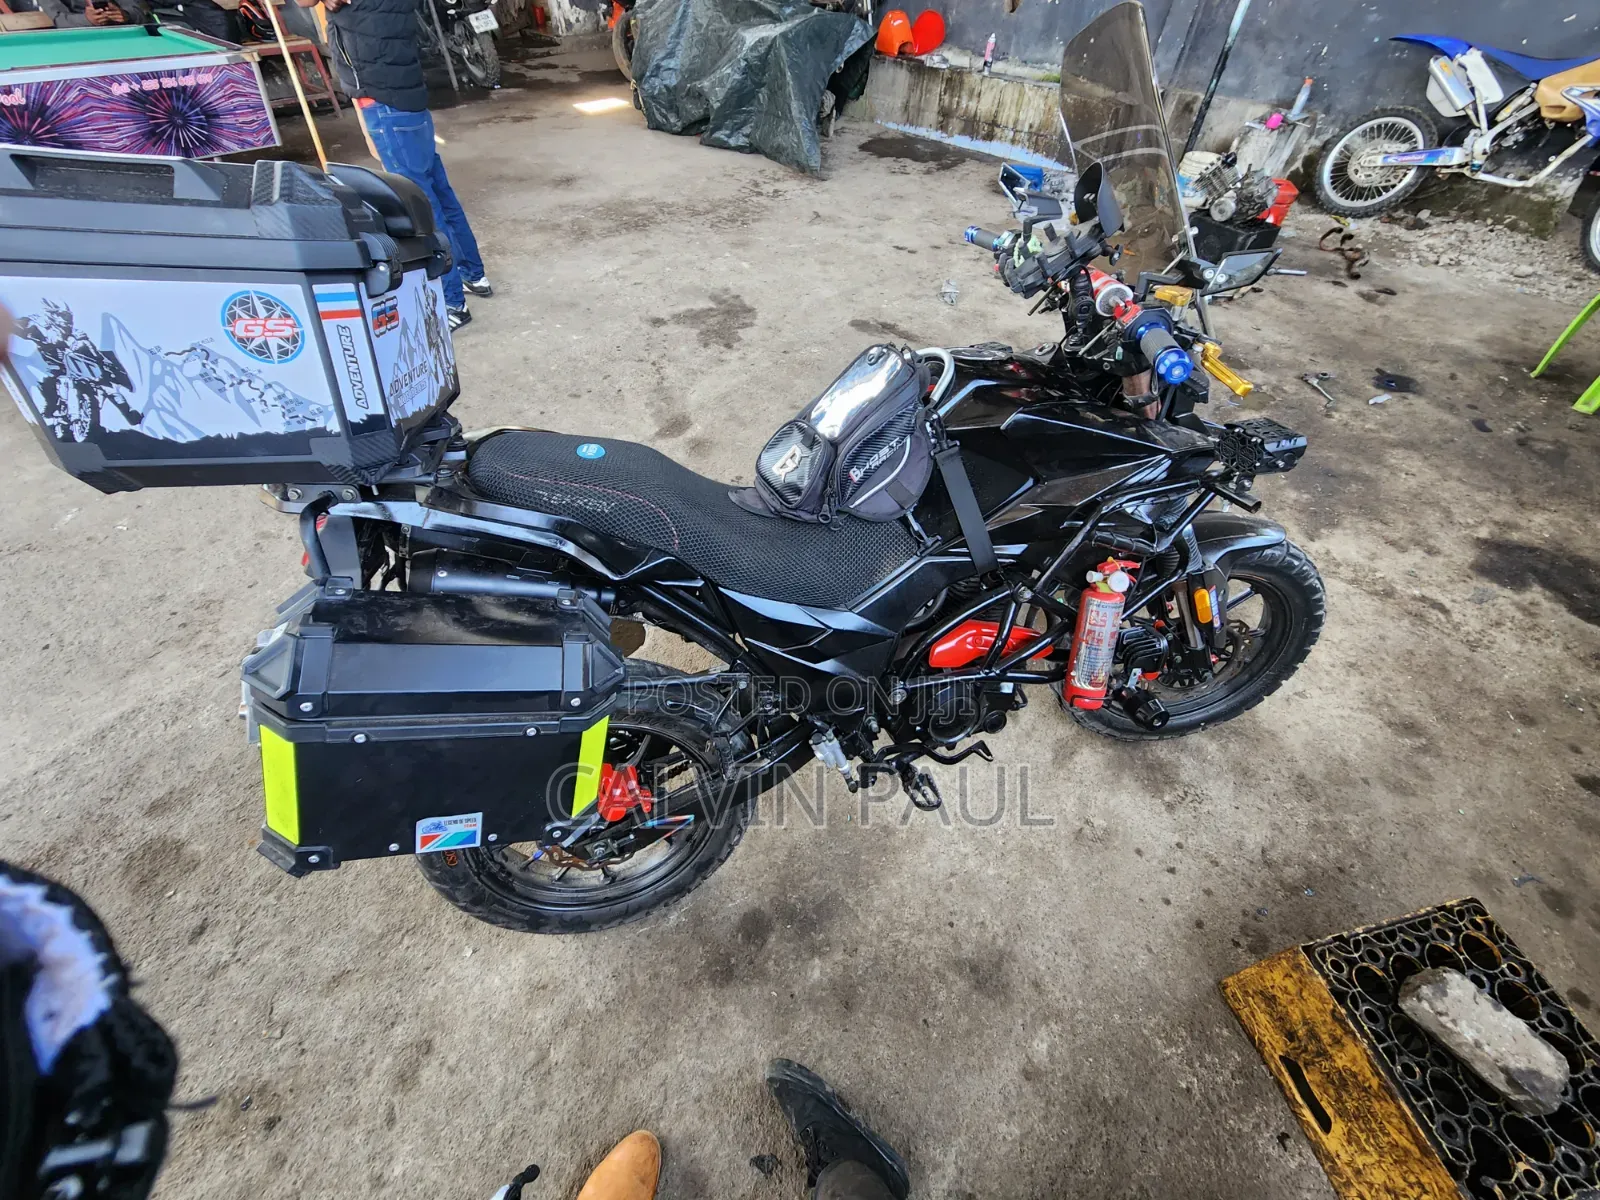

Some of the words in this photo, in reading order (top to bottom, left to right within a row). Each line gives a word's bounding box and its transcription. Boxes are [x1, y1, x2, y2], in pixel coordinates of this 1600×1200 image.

[0, 88, 26, 106] ool
[232, 317, 296, 339] GS
[371, 295, 399, 338] GS
[336, 324, 369, 409] ADVENTURE
[389, 360, 428, 397] ADVENTURE
[871, 438, 905, 469] RACIN
